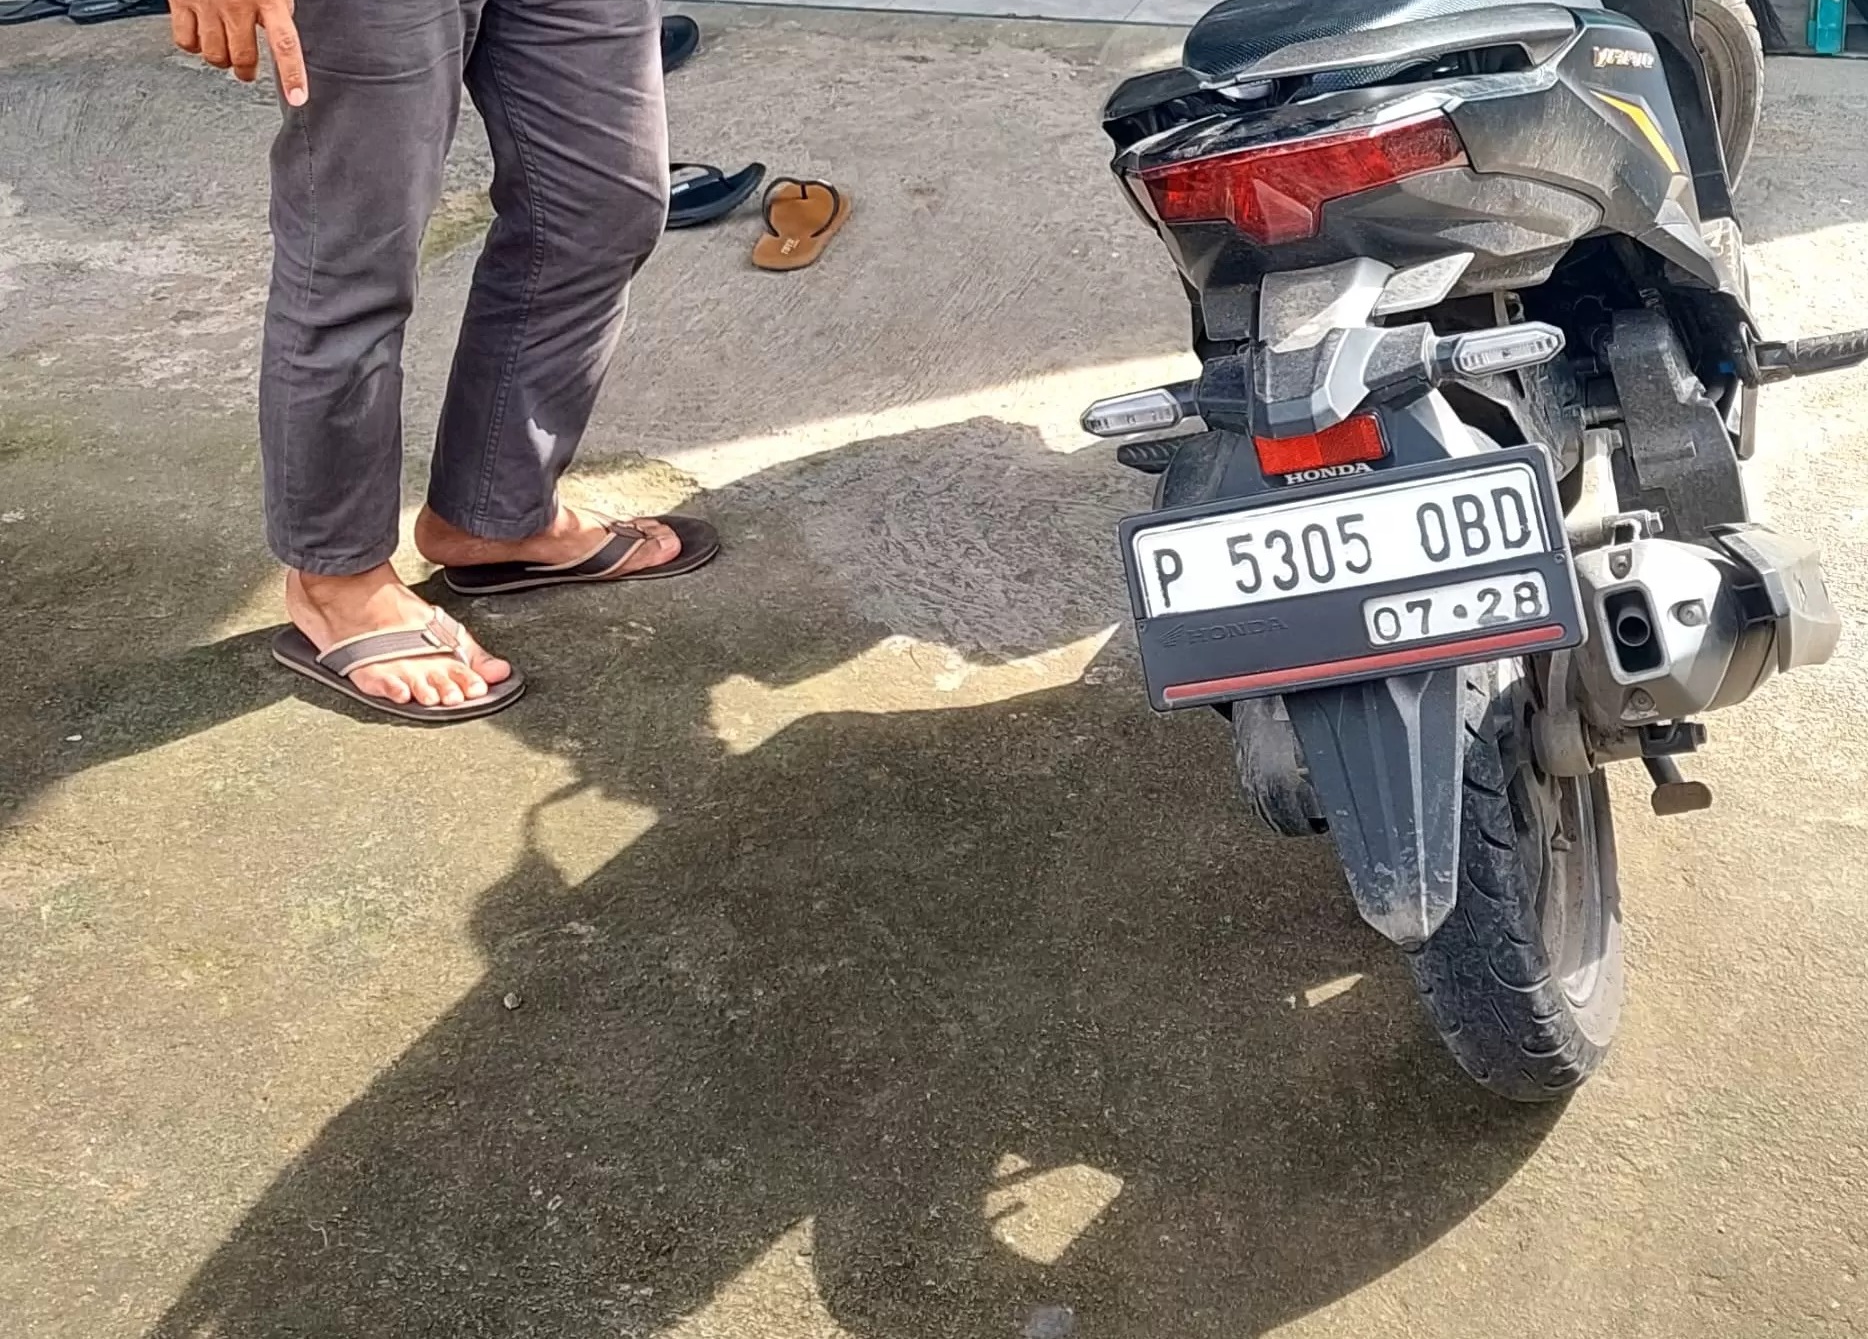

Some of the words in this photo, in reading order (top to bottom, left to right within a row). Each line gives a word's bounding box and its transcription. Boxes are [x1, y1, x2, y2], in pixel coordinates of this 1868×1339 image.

[1284, 462, 1374, 485] HONDA
[1152, 548, 1184, 608] P
[1226, 513, 1373, 595] 5305
[1416, 486, 1533, 563] OBD
[1187, 617, 1289, 645] HONDA
